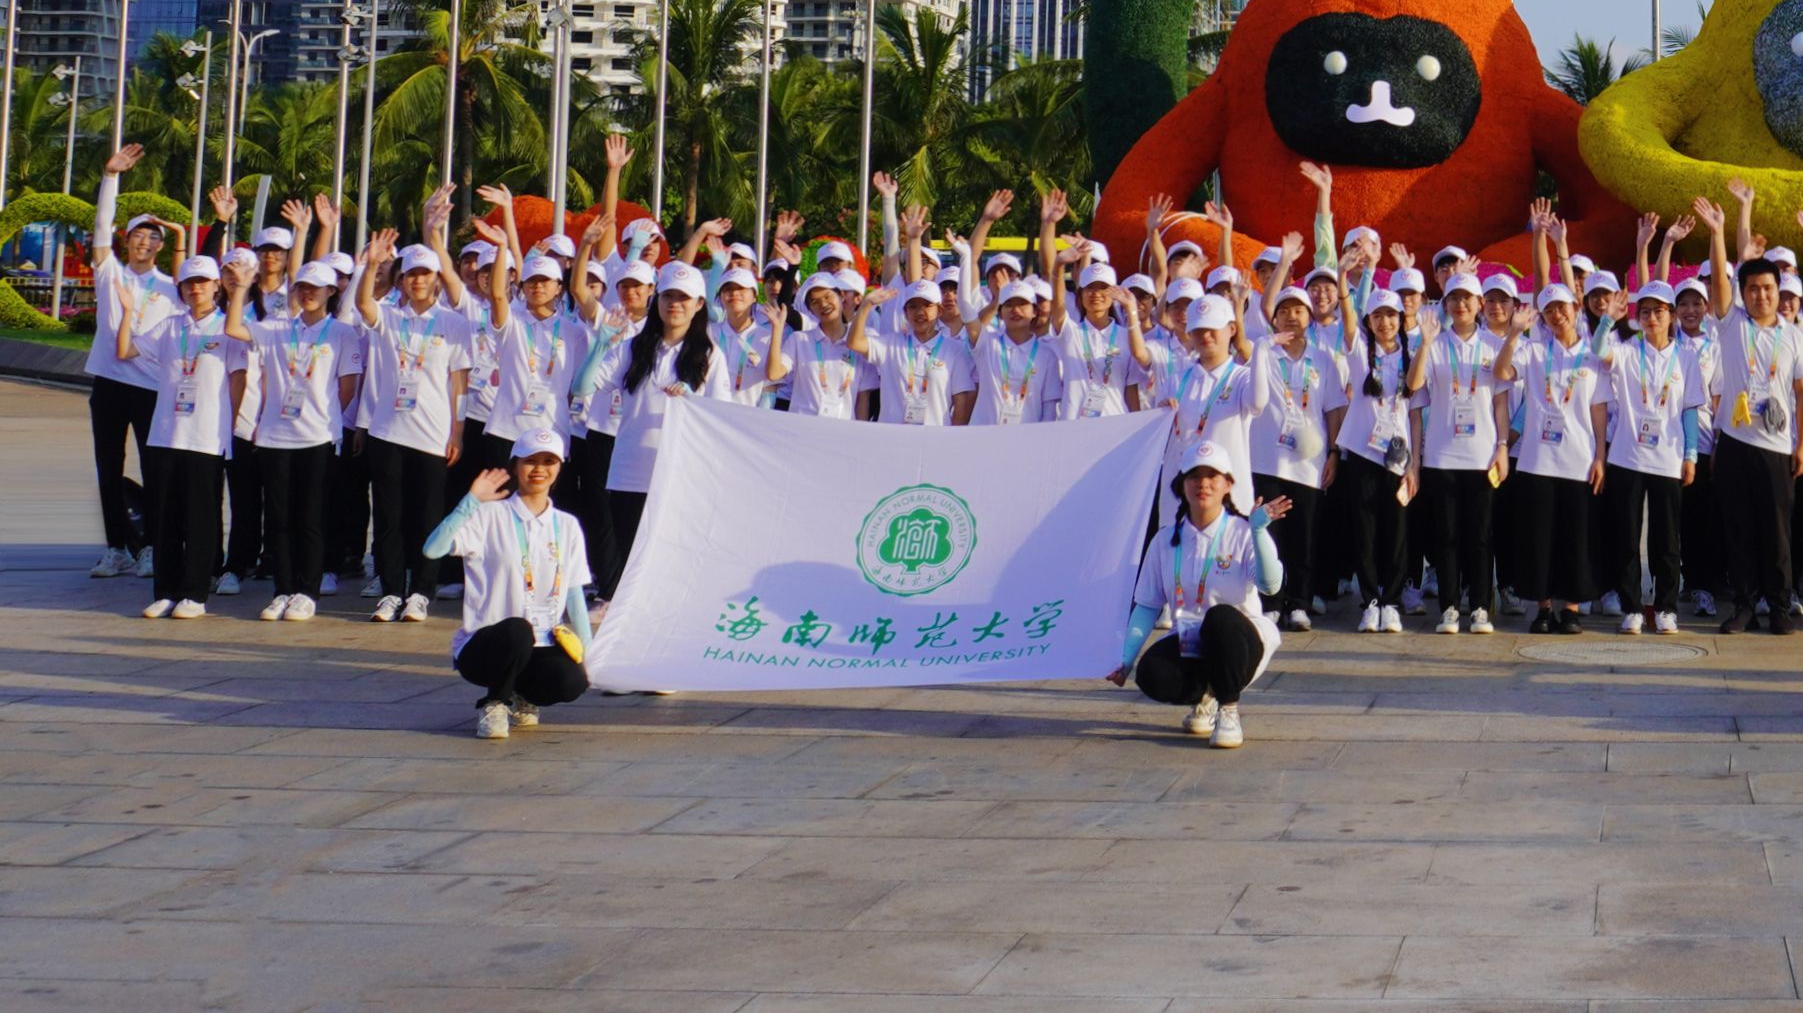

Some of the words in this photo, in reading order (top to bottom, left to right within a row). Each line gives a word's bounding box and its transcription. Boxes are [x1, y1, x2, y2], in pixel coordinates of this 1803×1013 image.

[867, 509, 892, 547] HAINAN
[893, 494, 937, 511] NORMAL
[940, 499, 968, 548] UNIVERSITY
[715, 597, 1065, 656] 海南师范大学
[703, 647, 799, 668] HAINAN
[807, 658, 908, 669] NORMAL
[920, 643, 1051, 667] UNIVERSITY
